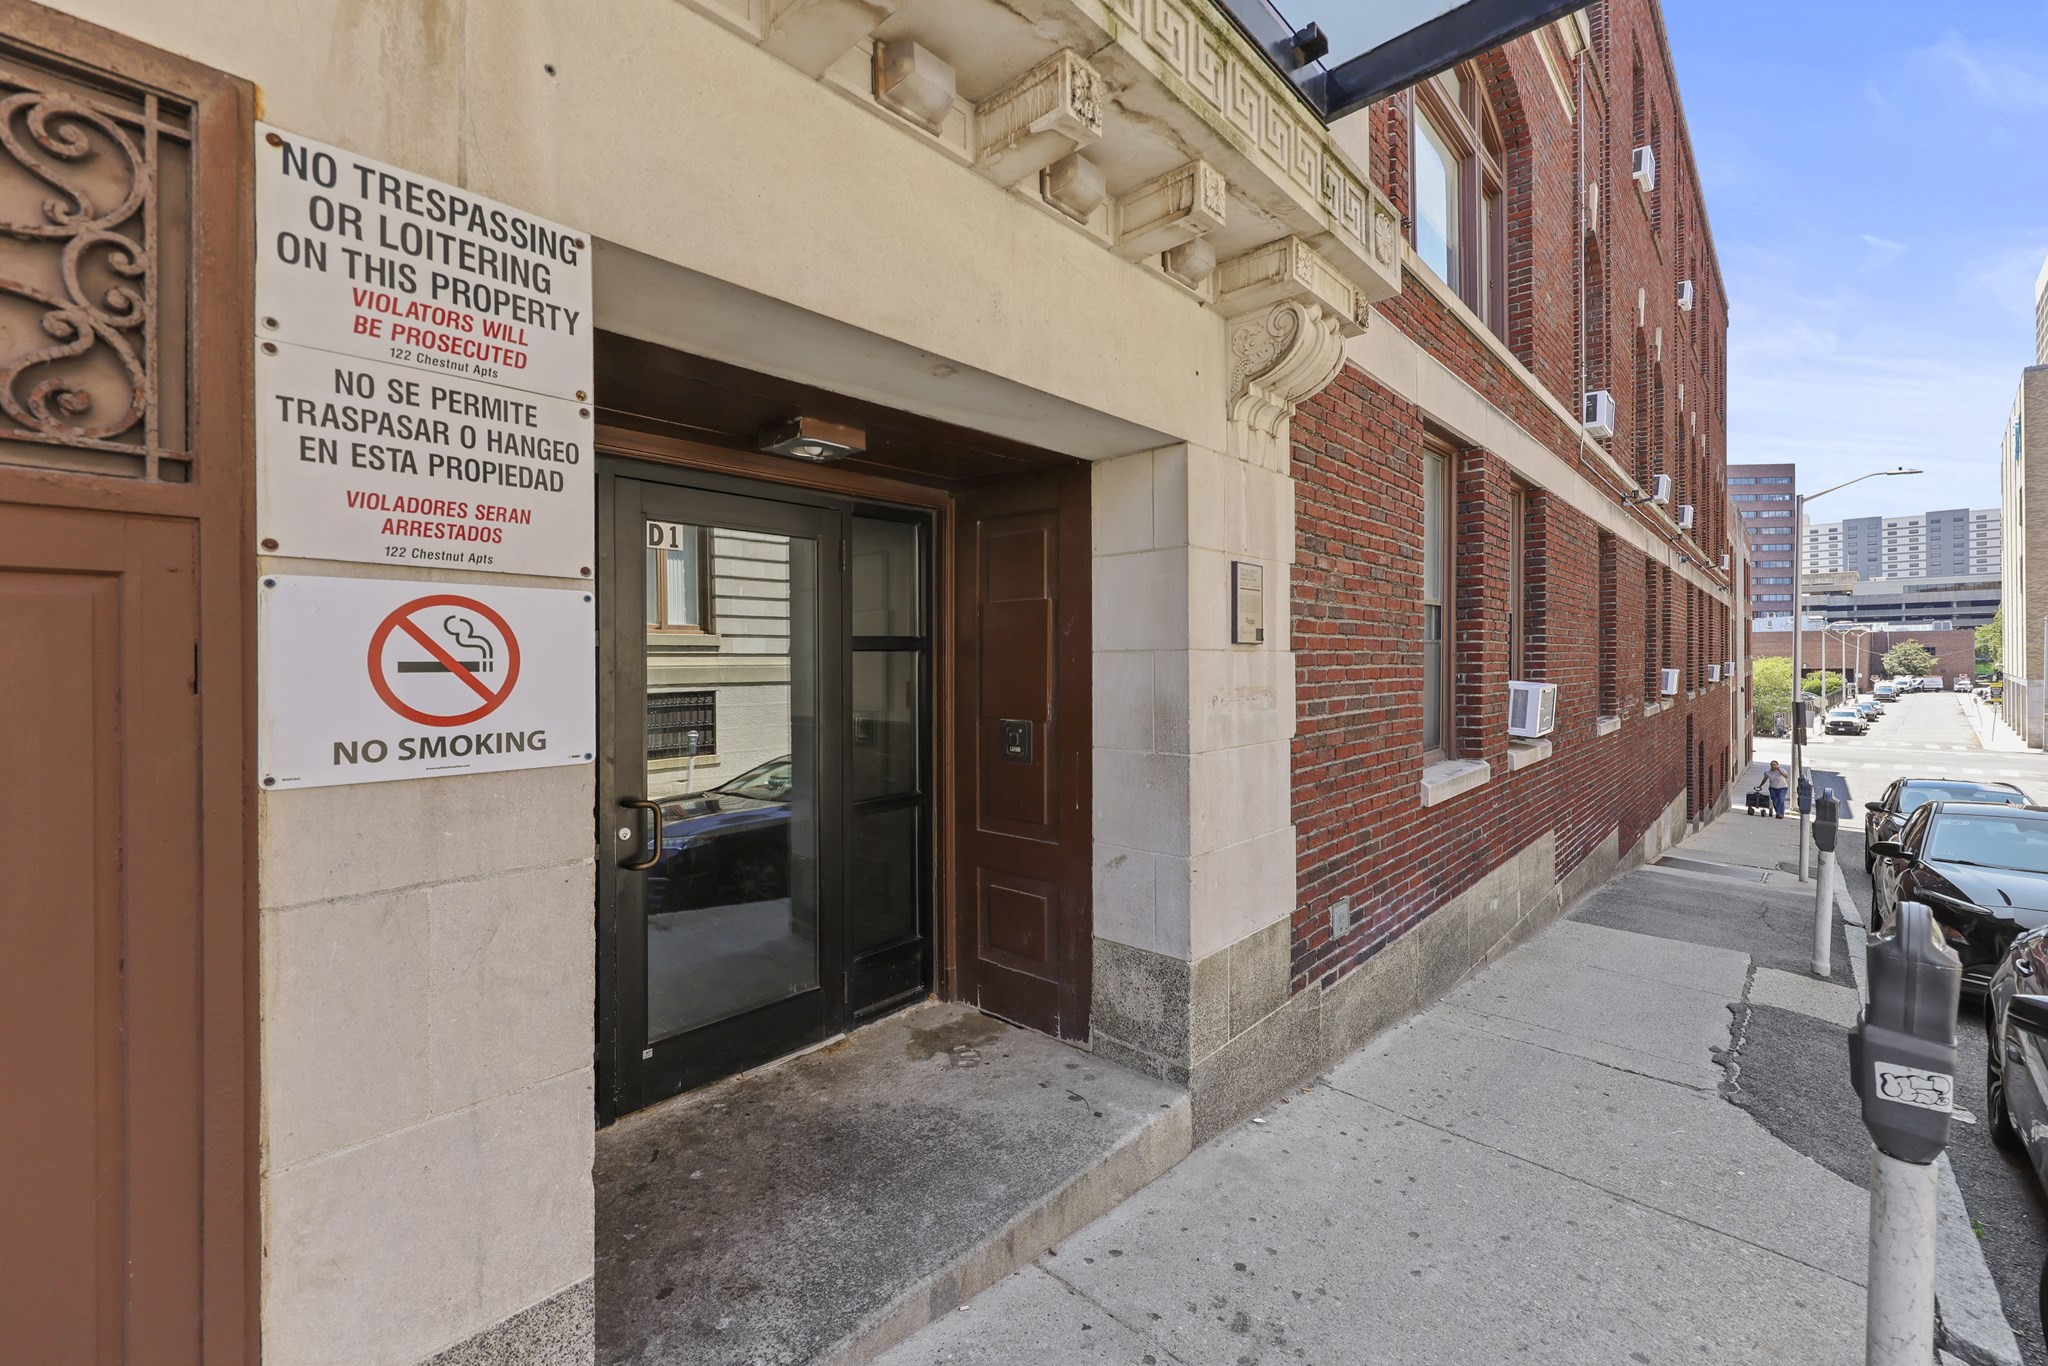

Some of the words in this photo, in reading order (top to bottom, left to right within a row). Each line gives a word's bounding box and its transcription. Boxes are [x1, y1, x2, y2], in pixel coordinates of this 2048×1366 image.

[283, 141, 337, 189] NO
[353, 163, 578, 267] TRESPASSING
[309, 195, 363, 241] OR
[380, 215, 551, 296] LOITERING
[277, 232, 327, 273] ON
[341, 247, 417, 294] THIS
[432, 271, 580, 336] PROPERTY
[352, 287, 474, 333] VIOLATORS
[483, 319, 529, 347] WILL
[353, 315, 382, 339] BE
[391, 323, 528, 370] PROSECUTED
[390, 348, 412, 362] 122
[416, 353, 469, 374] Chestnut
[473, 360, 499, 379] Apts
[335, 369, 375, 399] NO
[387, 379, 420, 407] SE
[432, 386, 538, 428] PERMITE
[275, 395, 450, 445] TRASPASAR
[460, 425, 476, 449] O
[487, 429, 580, 465] HANGEO
[300, 435, 338, 465] EN
[352, 443, 418, 475] ESTA
[429, 453, 564, 493] PROPIEDAD
[346, 490, 468, 519] VIOLADORES
[474, 504, 531, 525] SERAN
[381, 518, 503, 544] ARRESTADOS
[384, 546, 407, 559] 122
[411, 548, 464, 564] Chestnut
[468, 552, 494, 566] Apts
[333, 739, 388, 766] NO
[398, 730, 547, 761] SMOKING
